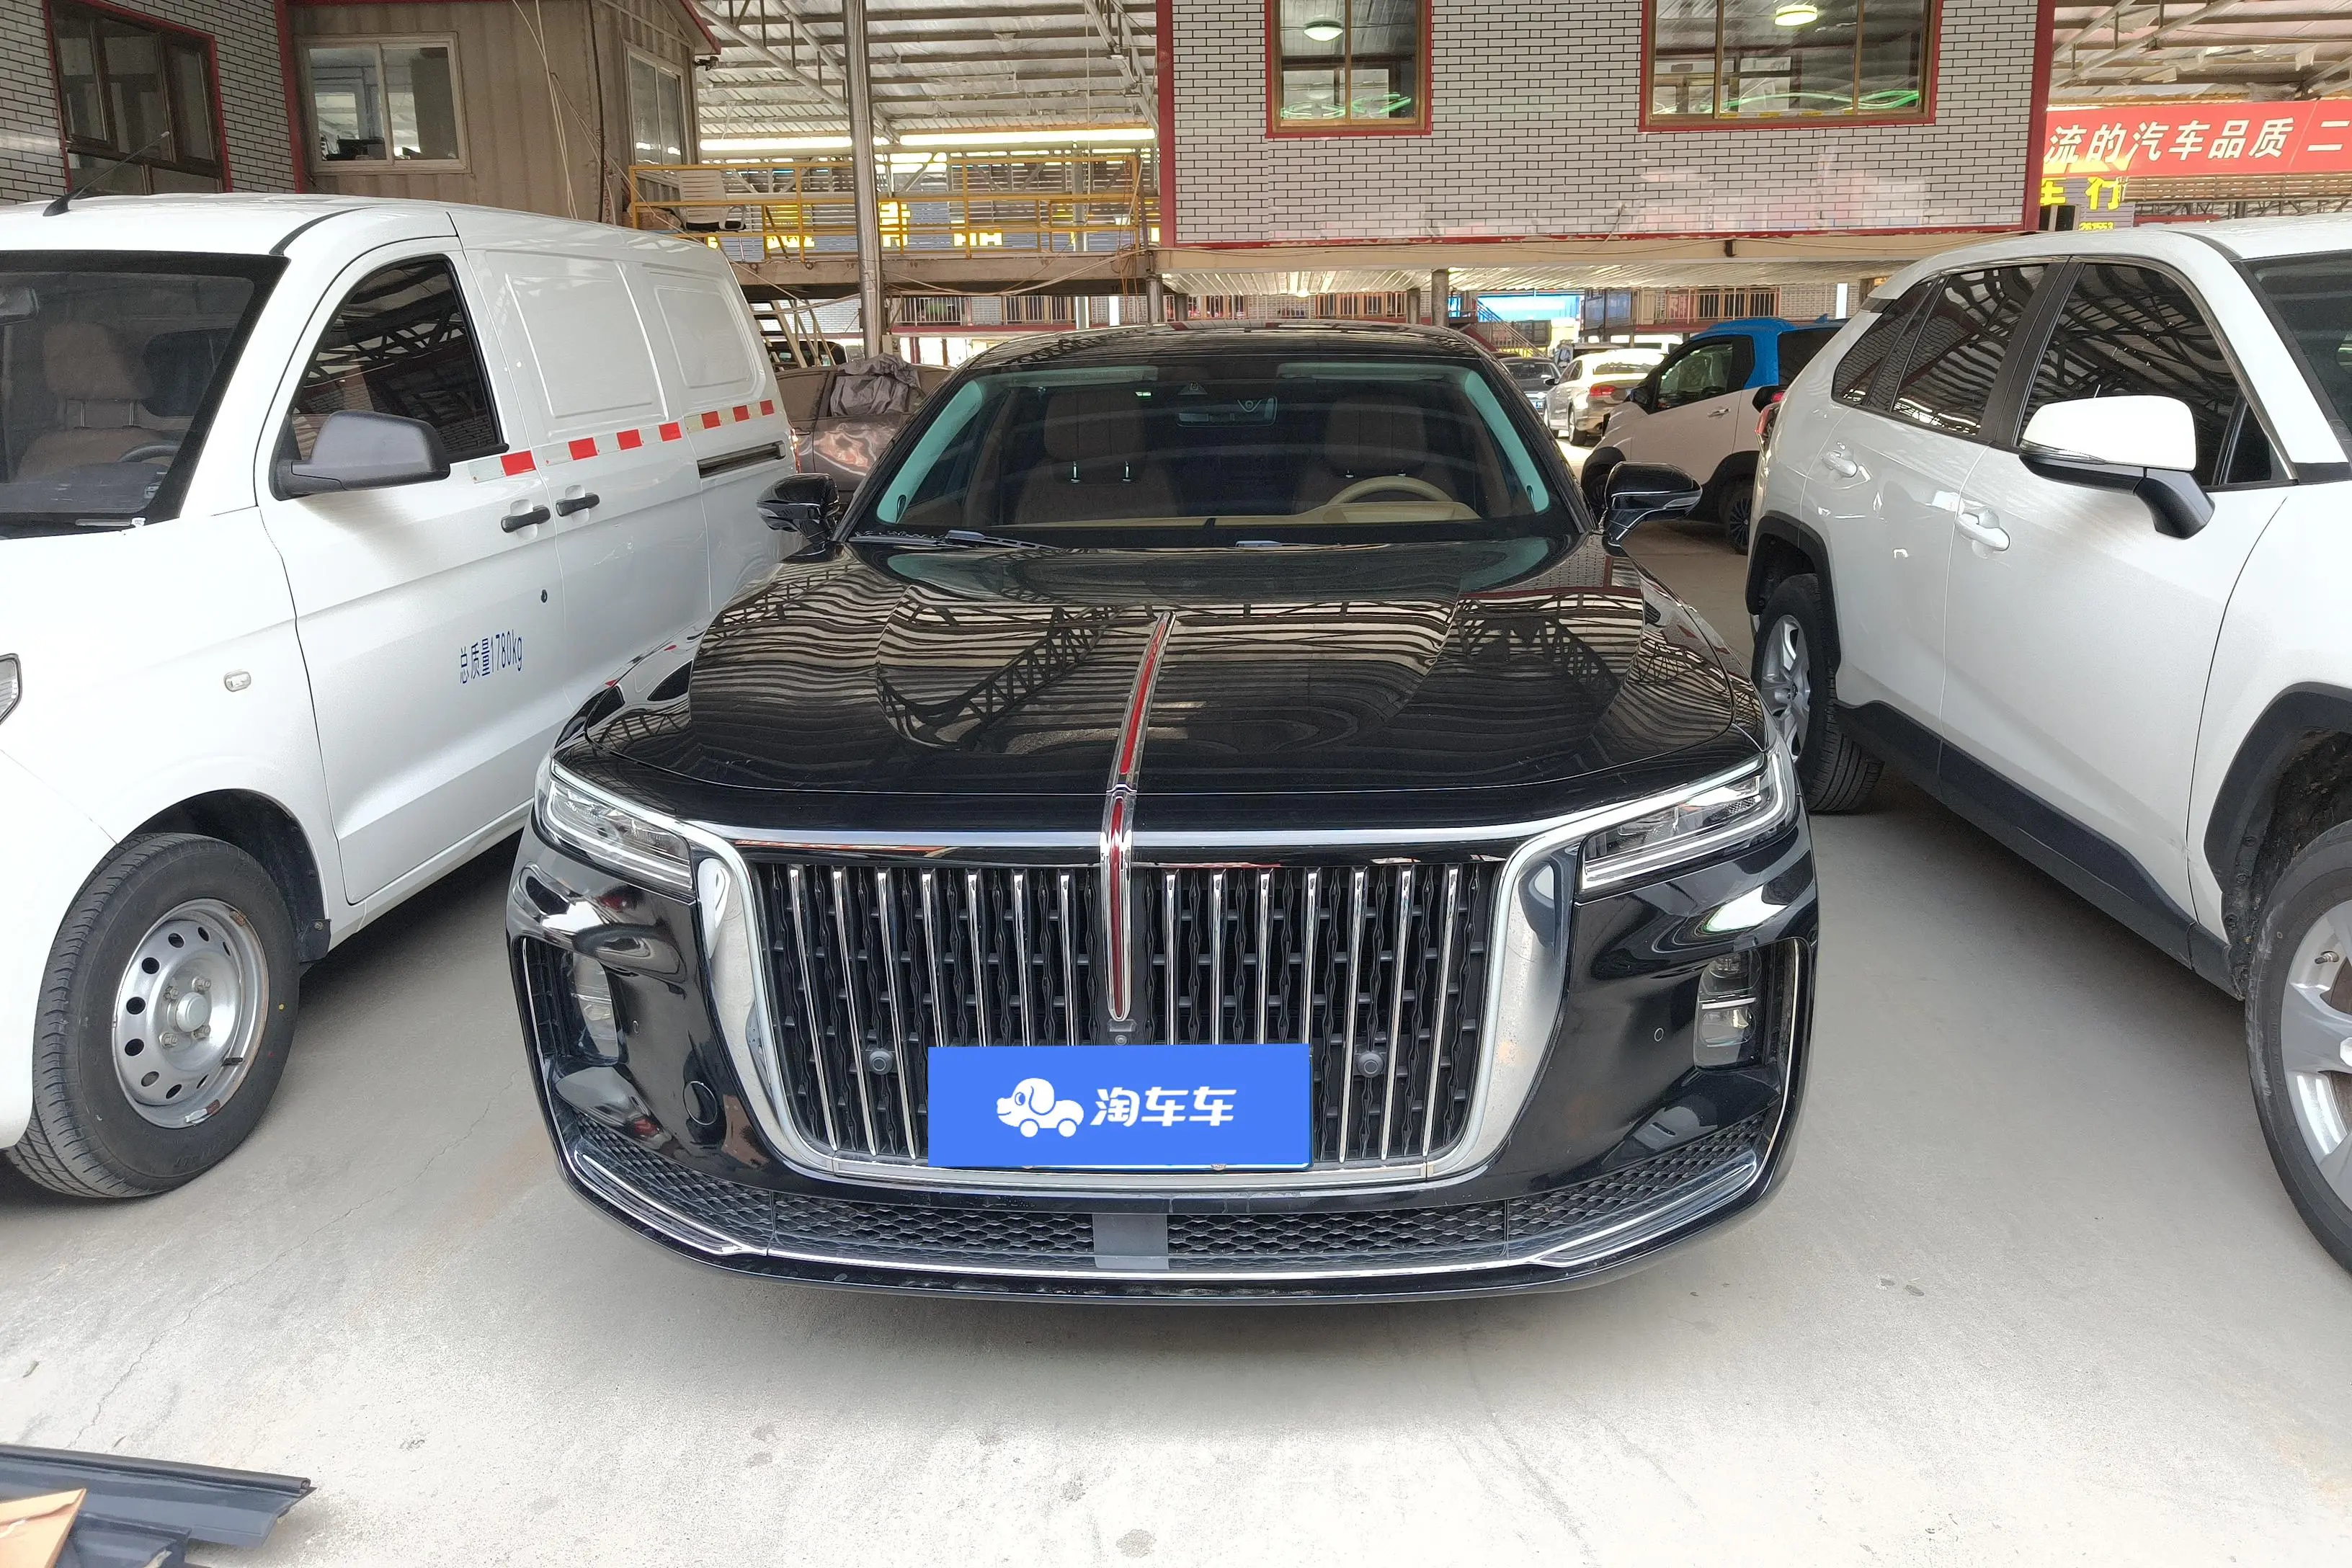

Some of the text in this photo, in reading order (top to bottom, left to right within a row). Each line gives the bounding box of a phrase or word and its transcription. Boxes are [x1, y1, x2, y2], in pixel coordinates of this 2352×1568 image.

[2043, 117, 2294, 164] 流的汽车品质
[460, 628, 522, 684] 总质量1780kg
